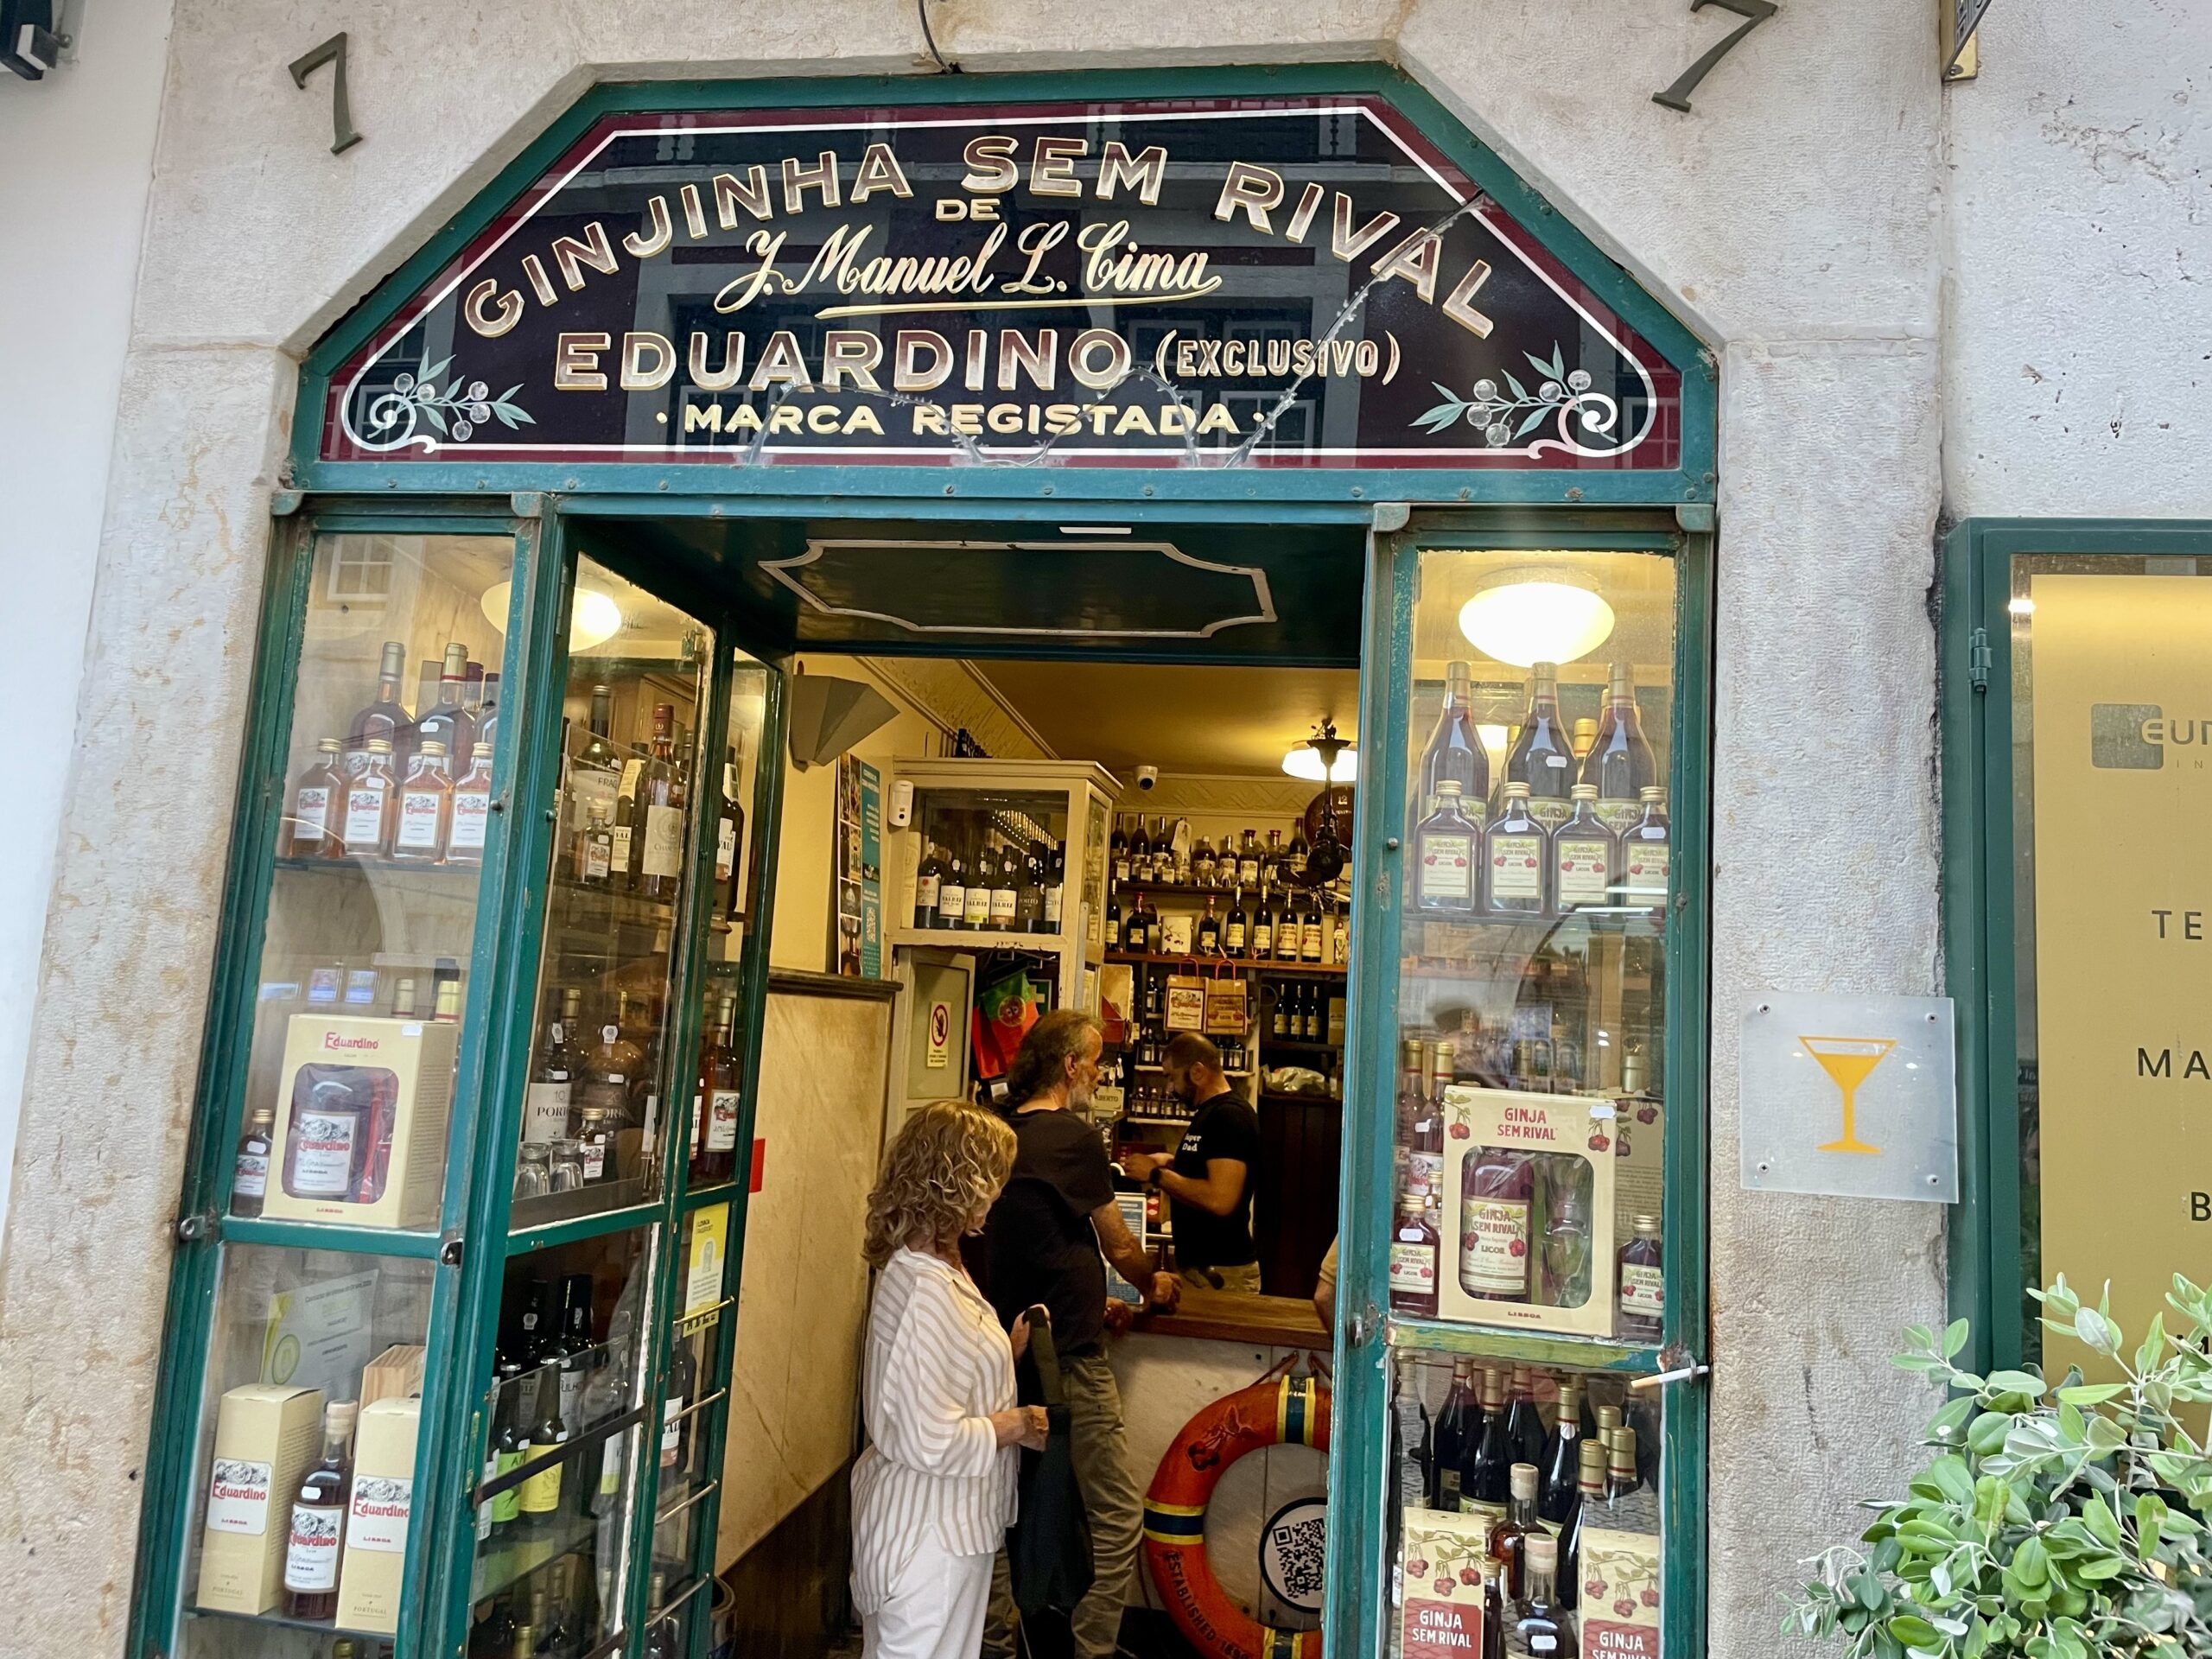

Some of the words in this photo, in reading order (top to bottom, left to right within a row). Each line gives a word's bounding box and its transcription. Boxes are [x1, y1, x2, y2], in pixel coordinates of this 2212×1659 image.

[1651, 0, 1778, 113] 7
[287, 31, 364, 156] 7
[935, 196, 1001, 223] DE
[464, 143, 914, 339] GINJINHA
[960, 135, 1169, 207] SEM
[1213, 160, 1495, 340] RIVAL
[774, 221, 1007, 297] Manuel
[1001, 221, 1068, 295] L.
[1075, 219, 1224, 291] Cima
[554, 327, 1133, 393] EDUARDINO
[1155, 328, 1402, 387] (EXCLUSIVO)
[684, 404, 886, 435] MARCA
[912, 403, 1243, 436] REGISTADA
[2152, 909, 2203, 941] TE
[324, 1032, 379, 1050] Eduardino
[1504, 1107, 1547, 1124] GINJA
[1497, 1124, 1521, 1138] SEM
[1523, 1126, 1556, 1141] RIVAL
[1181, 1143, 1198, 1152] Dad
[1478, 1209, 1511, 1222] GINJA
[1473, 1221, 1491, 1233] SEM
[1492, 1224, 1518, 1235] RIVAL
[1480, 1245, 1506, 1255] LICOR
[212, 1479, 266, 1501] Eduardino
[1420, 1610, 1463, 1630] GINJA
[1412, 1628, 1436, 1643] SEM
[1439, 1630, 1472, 1648] RIVAL
[1599, 1631, 1644, 1651] GINJA
